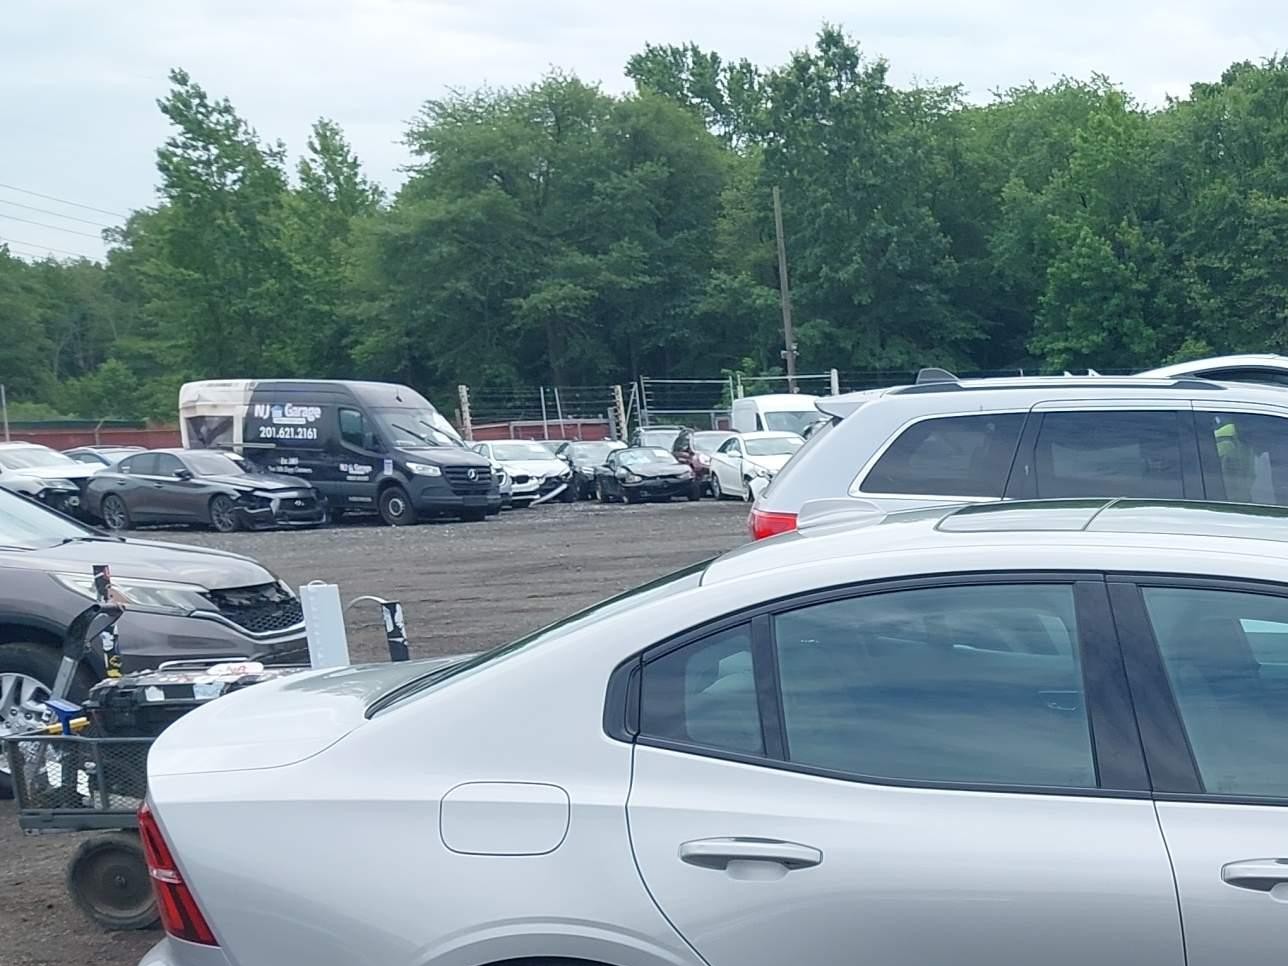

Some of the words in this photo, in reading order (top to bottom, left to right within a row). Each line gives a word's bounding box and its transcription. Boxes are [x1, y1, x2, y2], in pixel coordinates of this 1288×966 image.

[254, 404, 271, 420] NJ
[284, 403, 322, 422] Garage
[259, 426, 318, 440] 201.621.2161
